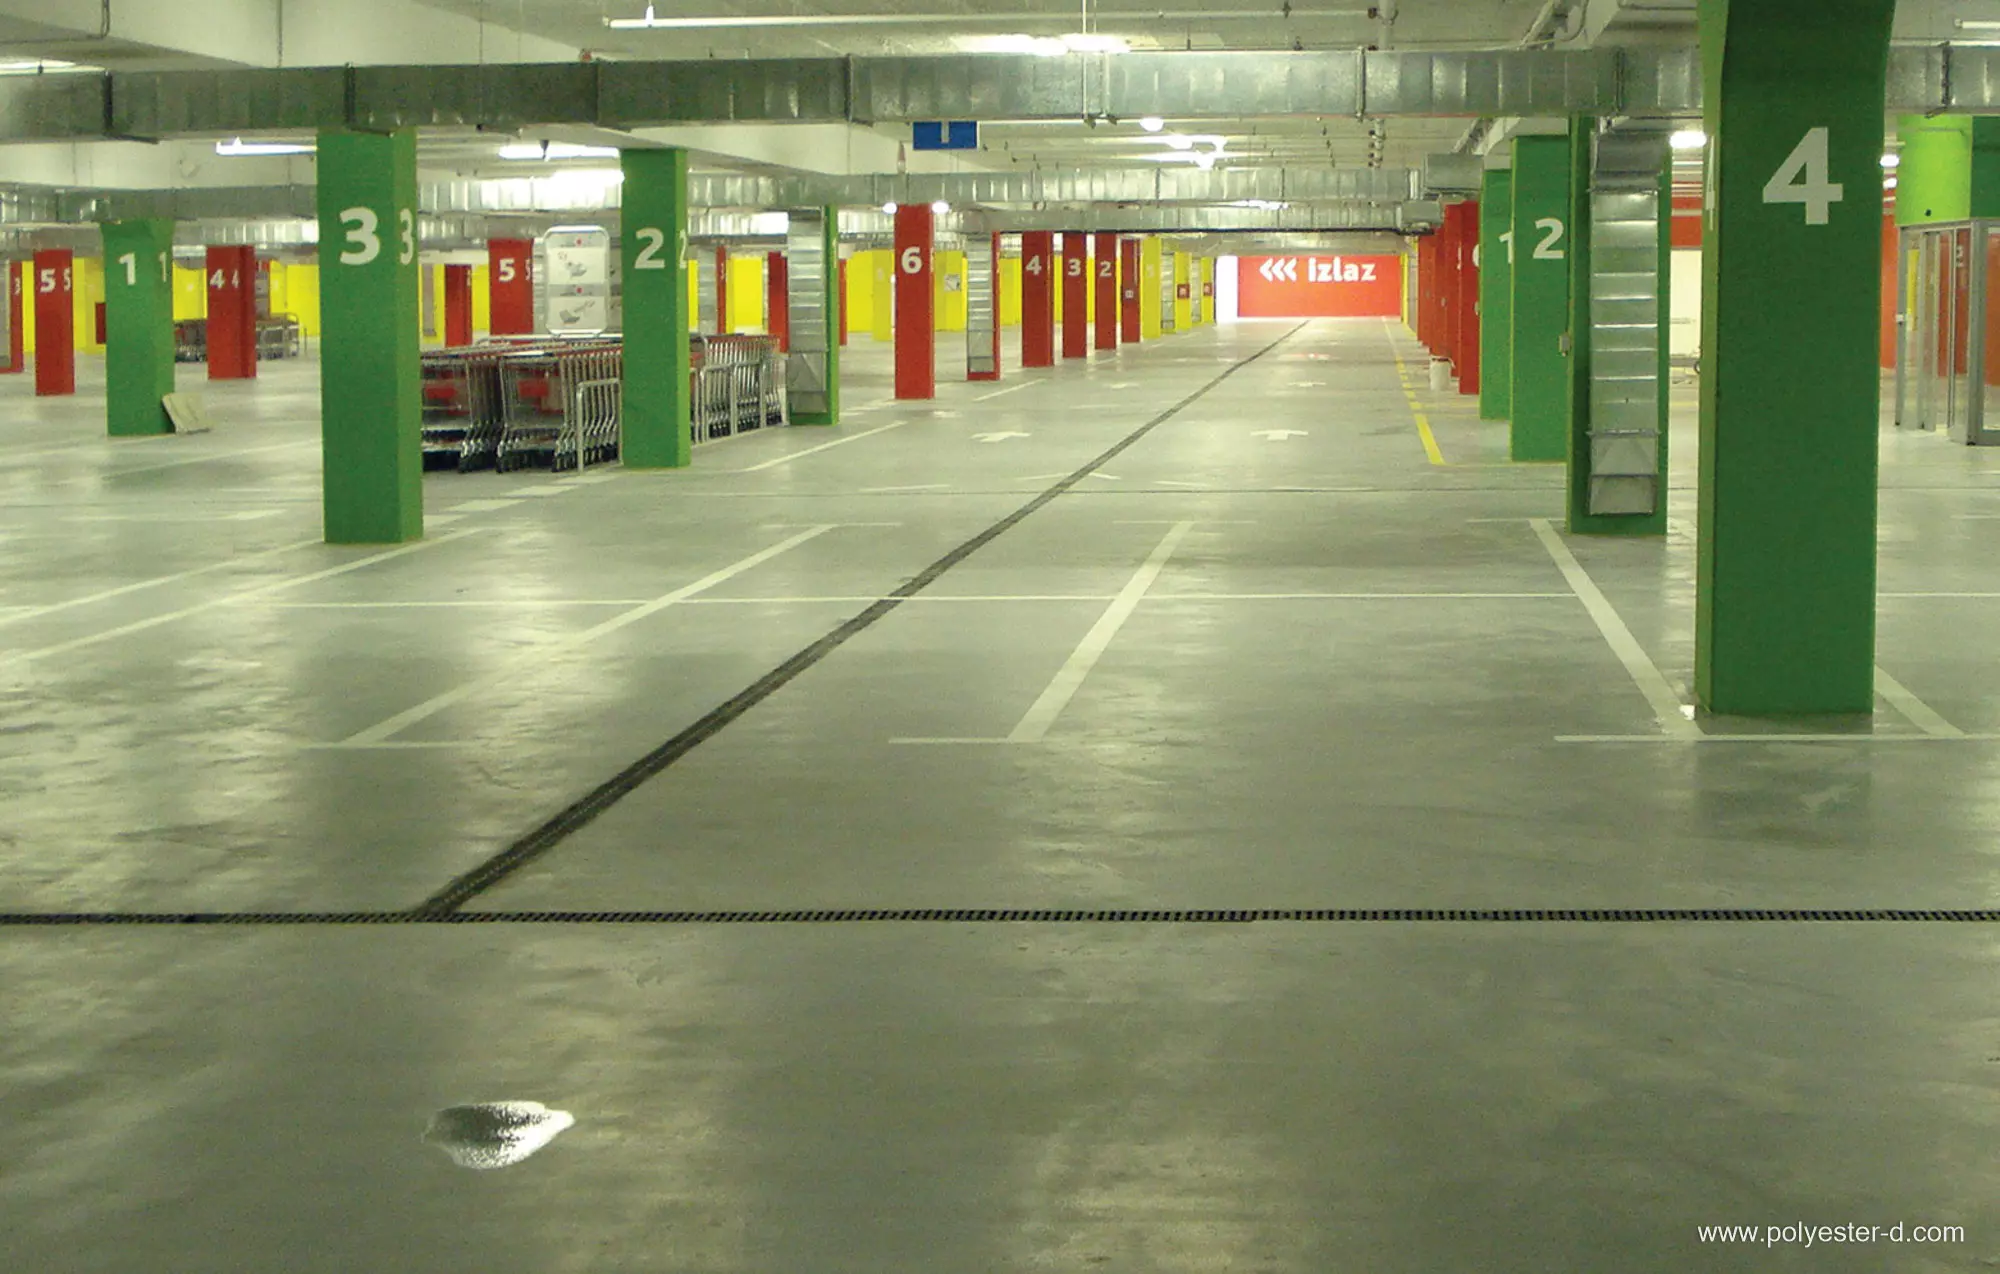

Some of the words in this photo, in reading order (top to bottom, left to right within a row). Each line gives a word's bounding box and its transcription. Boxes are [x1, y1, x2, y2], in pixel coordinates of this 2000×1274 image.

[1762, 127, 1843, 225] 4
[339, 206, 381, 265] 3
[400, 208, 414, 265] 3
[634, 227, 666, 269] 2
[1498, 231, 1513, 264] 1
[1532, 217, 1565, 260] 2
[119, 252, 136, 285] 1
[159, 252, 167, 283] 1
[498, 257, 516, 282] 5
[901, 246, 923, 274] 6
[1025, 255, 1042, 276] 4
[1067, 258, 1081, 277] 3
[1100, 261, 1113, 277] 2
[40, 267, 56, 292] 5
[209, 268, 225, 289] 4
